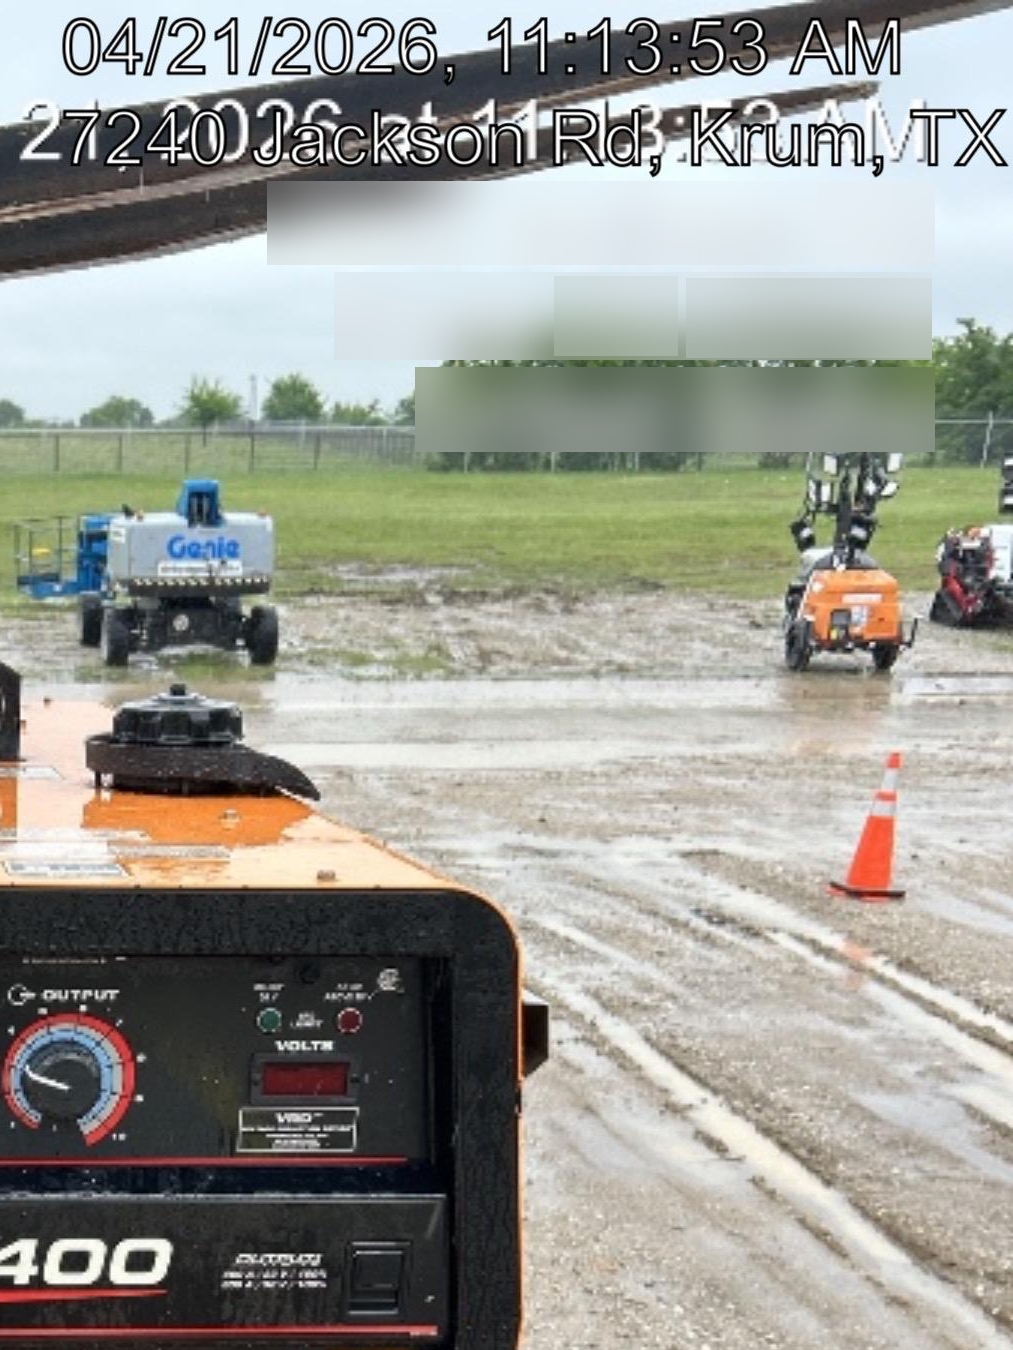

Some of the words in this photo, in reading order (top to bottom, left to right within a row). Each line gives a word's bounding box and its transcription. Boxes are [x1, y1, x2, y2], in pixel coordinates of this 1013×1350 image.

[167, 533, 240, 560] Genie
[41, 989, 120, 1001] OUTPUT
[275, 1040, 334, 1051] VOLTS
